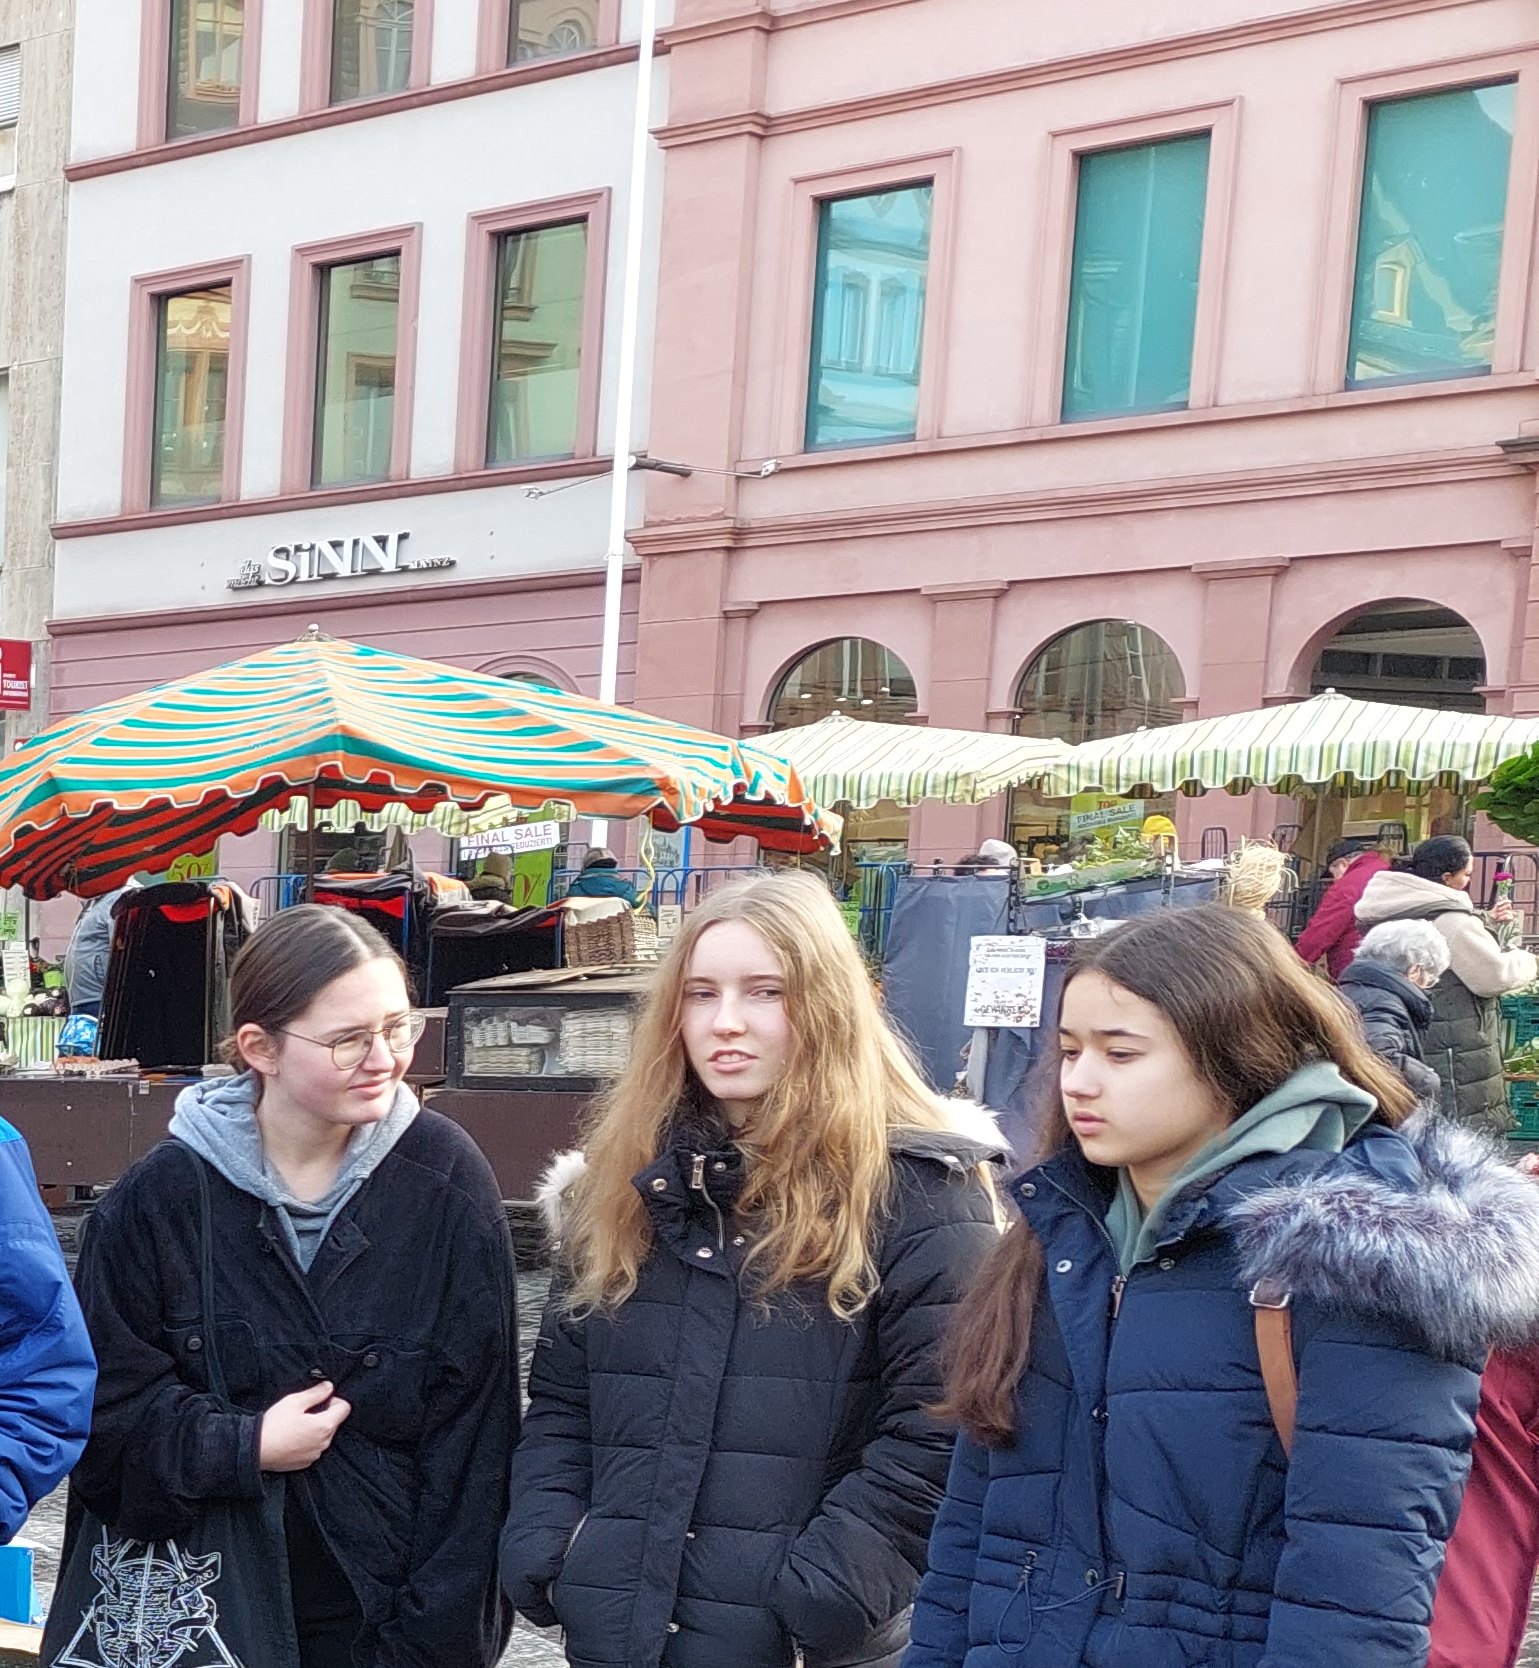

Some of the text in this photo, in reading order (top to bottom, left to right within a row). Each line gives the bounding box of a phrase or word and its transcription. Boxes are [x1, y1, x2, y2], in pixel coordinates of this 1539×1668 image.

[1076, 809, 1105, 824] FINAL
[1109, 804, 1137, 817] SALE
[468, 823, 553, 847] FINAL SALE
